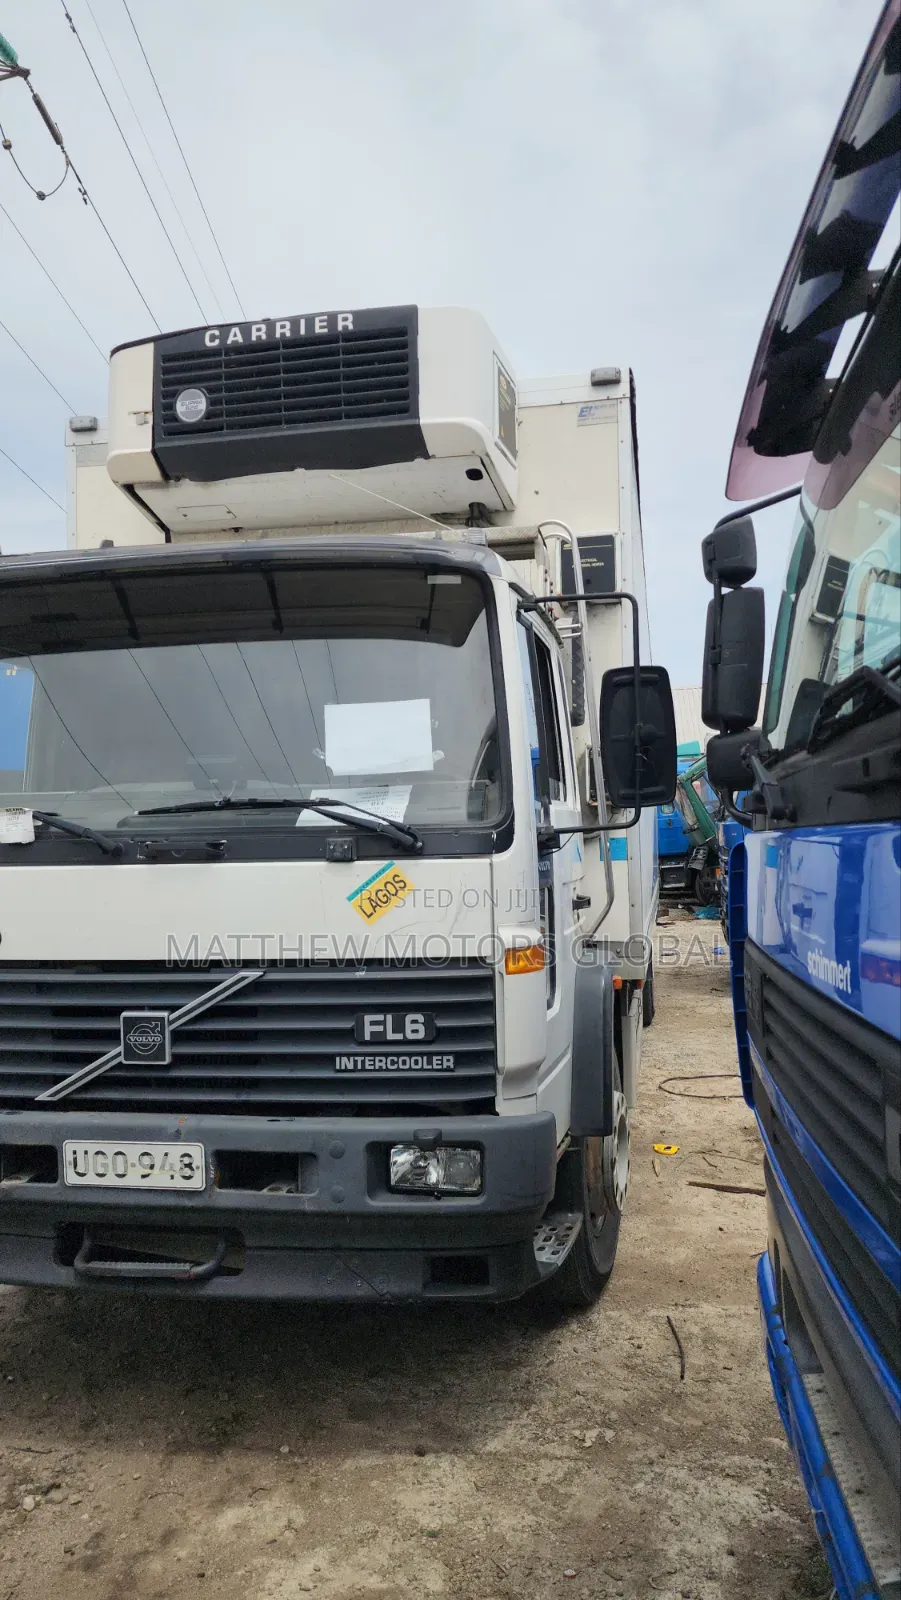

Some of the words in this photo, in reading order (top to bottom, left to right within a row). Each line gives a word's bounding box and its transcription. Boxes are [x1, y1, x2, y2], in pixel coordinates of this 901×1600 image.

[204, 313, 354, 347] CARRIER
[358, 873, 407, 919] LAGOS
[807, 948, 852, 994] schimmert
[364, 1013, 426, 1041] FL6
[335, 1055, 455, 1070] INTERCOOLER
